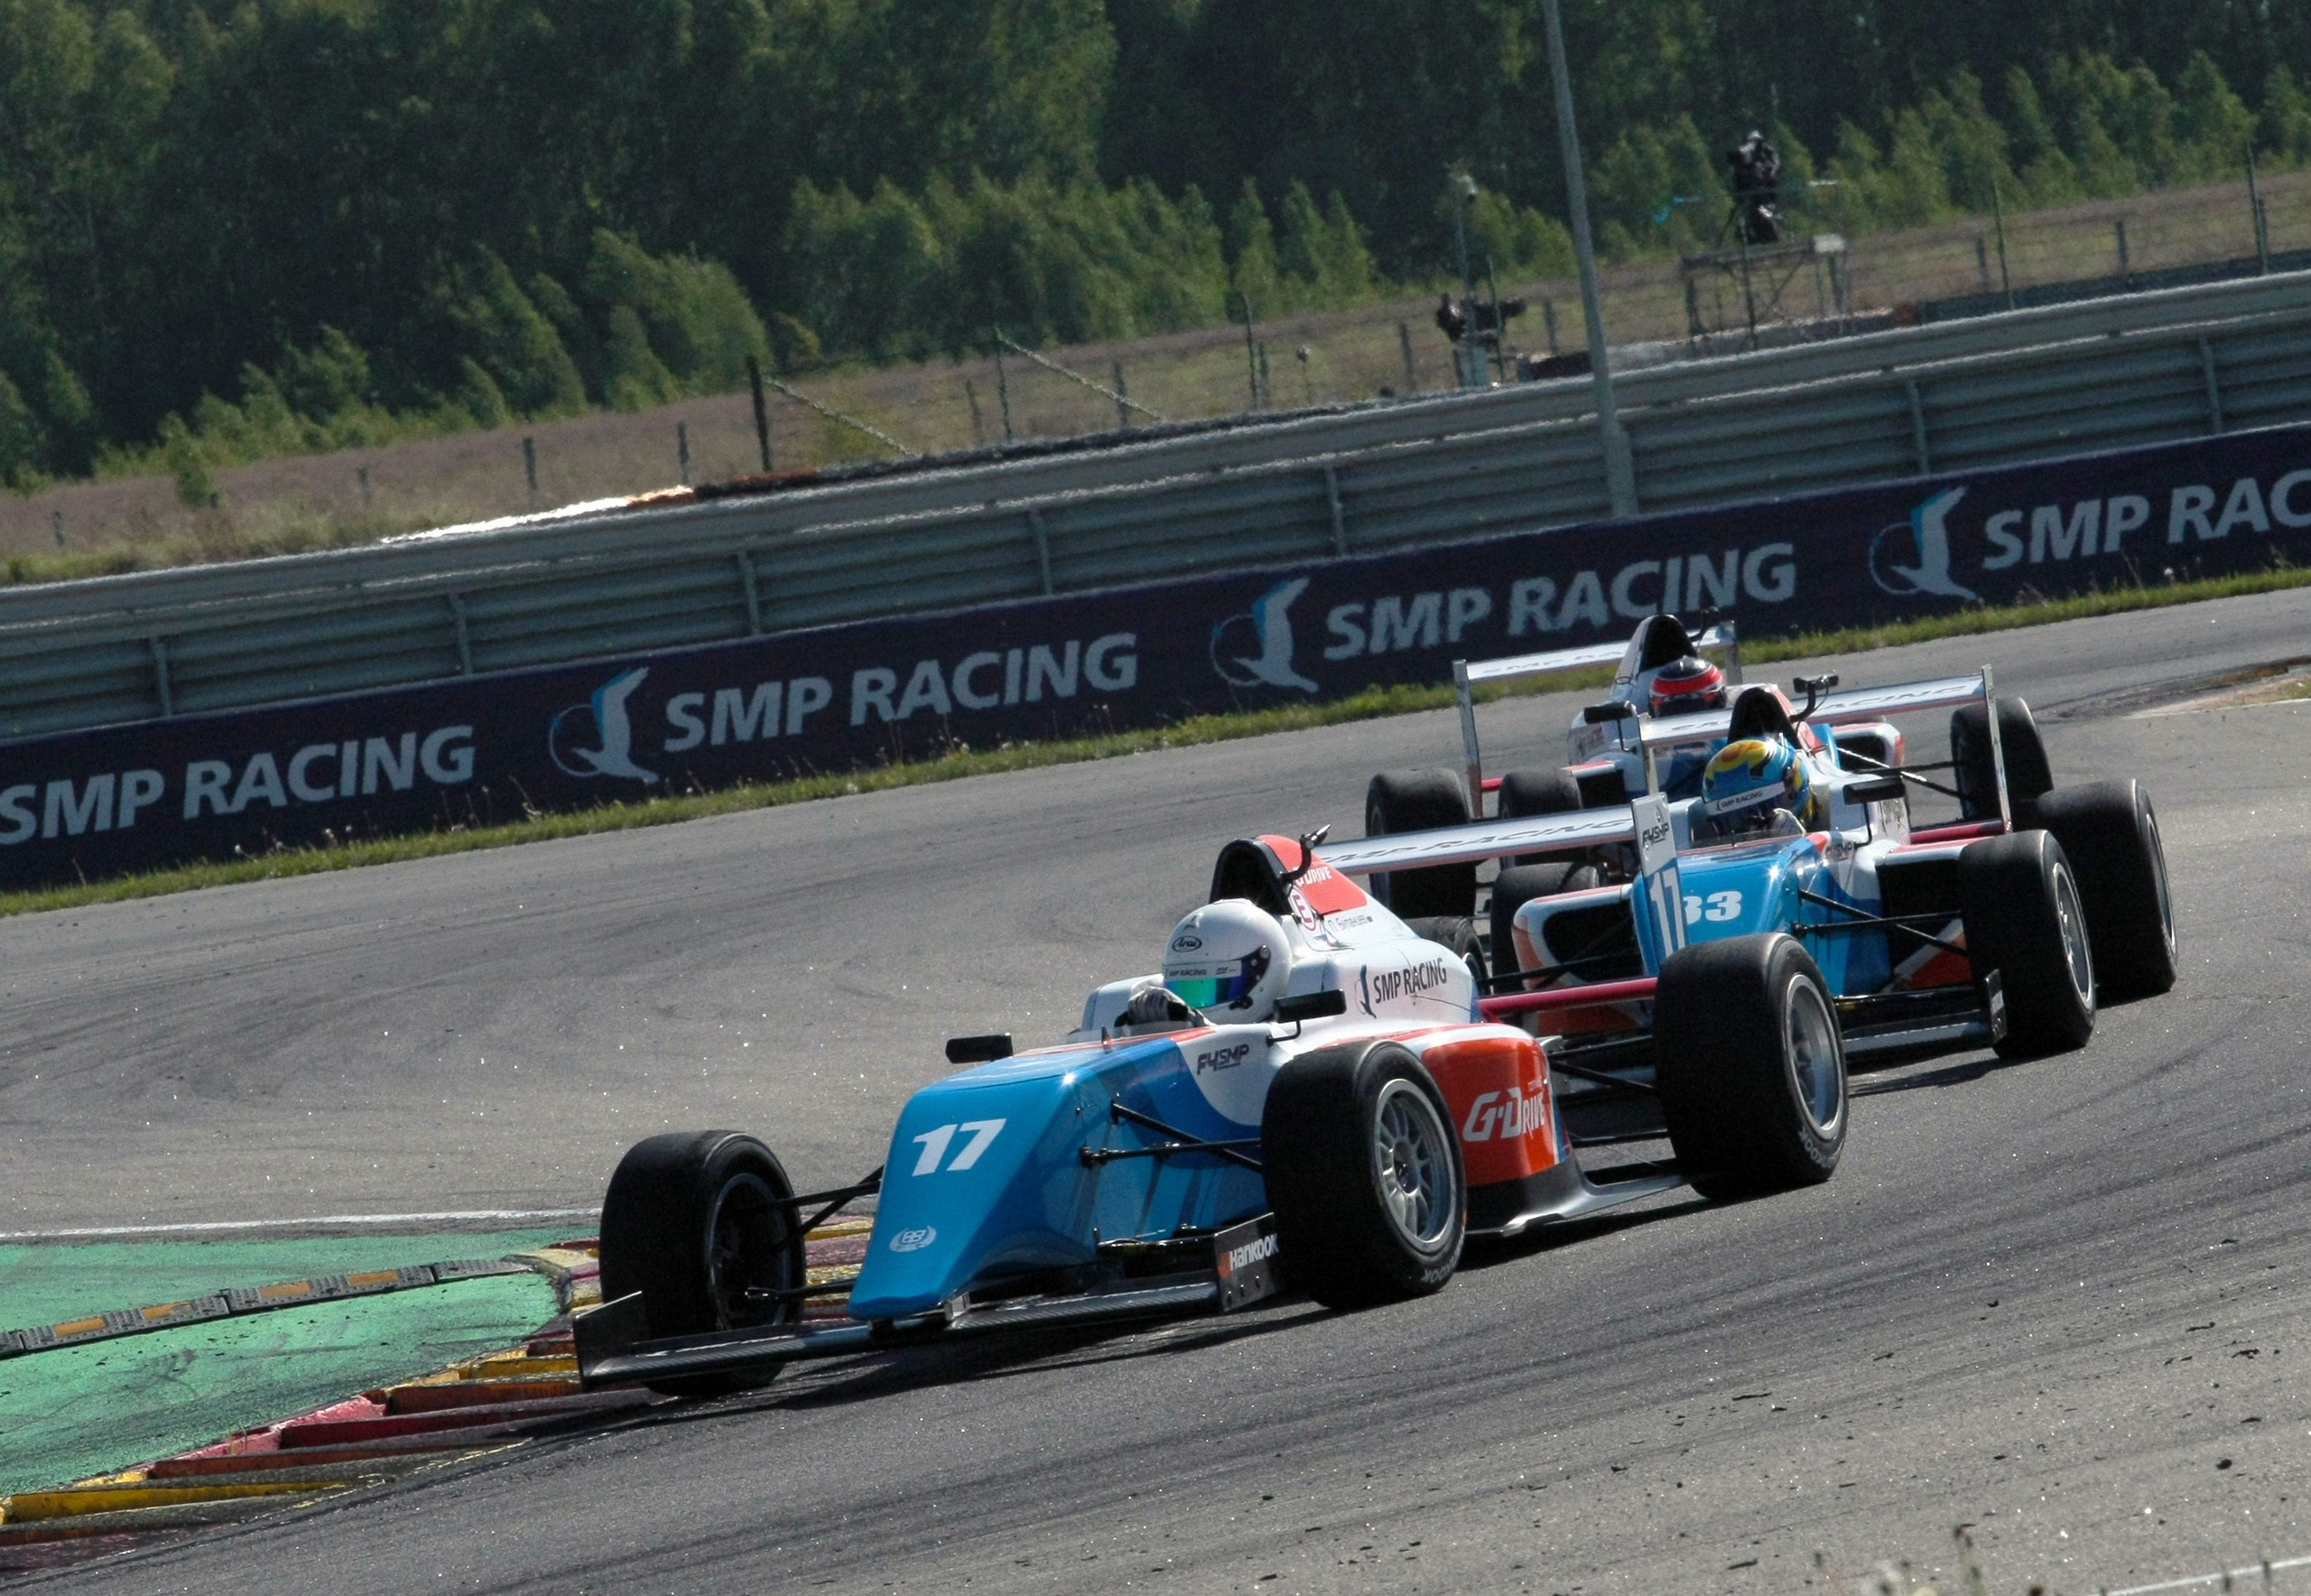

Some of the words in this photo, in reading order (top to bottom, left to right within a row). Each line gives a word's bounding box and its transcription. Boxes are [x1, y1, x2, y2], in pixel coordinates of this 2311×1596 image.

[1982, 495, 2150, 571] SMP
[1323, 587, 1491, 660] SMP
[1508, 543, 1796, 635] RACING
[664, 677, 832, 752] SMP
[850, 633, 1138, 726] RACING
[0, 769, 164, 846] SMP
[183, 726, 476, 820] RACING
[1421, 818, 1633, 851] RACING
[1292, 895, 1313, 923] E
[1373, 971, 1401, 1004] SMP
[1403, 957, 1447, 995] RACING
[911, 1118, 1007, 1176] 17
